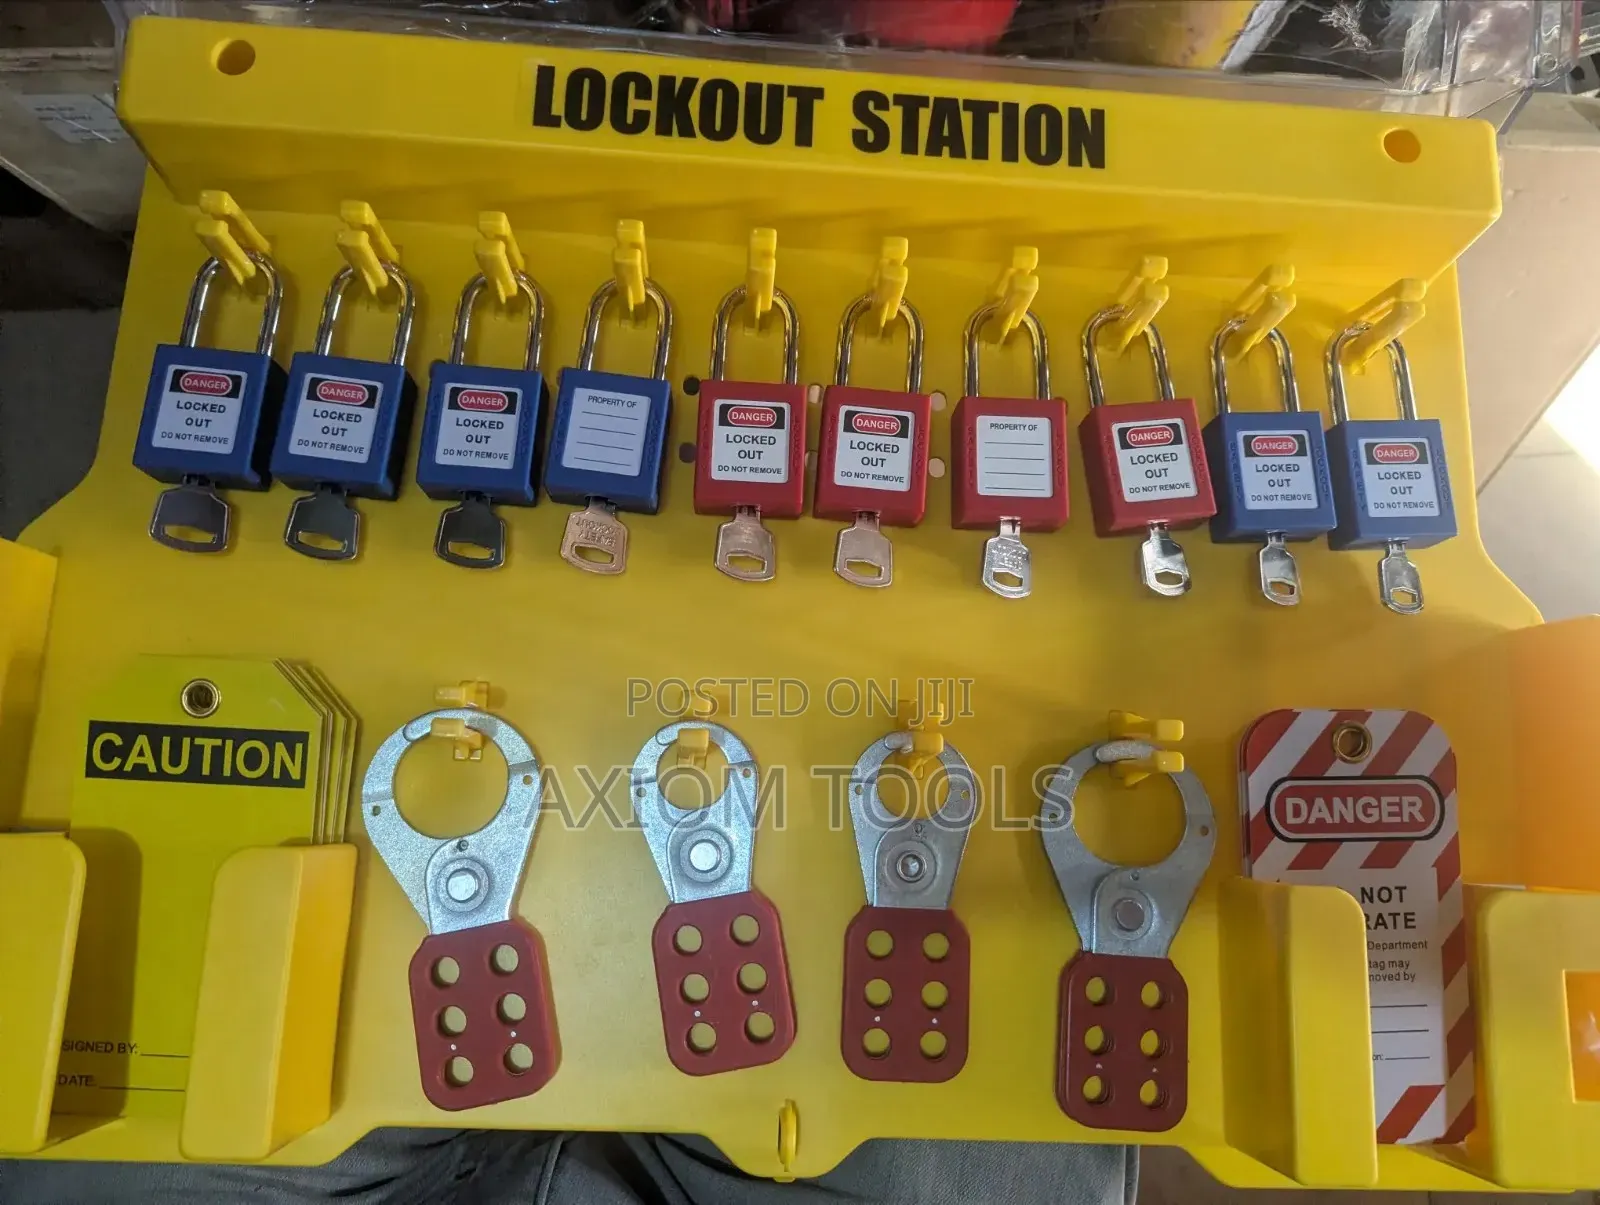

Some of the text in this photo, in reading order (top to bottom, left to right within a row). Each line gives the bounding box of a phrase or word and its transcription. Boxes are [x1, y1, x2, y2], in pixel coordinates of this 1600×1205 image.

[532, 64, 1105, 169] LOCKOUT STATION
[184, 378, 228, 390] DANGER
[320, 386, 364, 400] DANGER
[462, 395, 504, 407] DANGER
[587, 396, 638, 408] PROPERTY OF
[176, 400, 226, 414] LOCKED
[313, 409, 362, 423] LOCKED
[732, 412, 774, 422] DANGER
[185, 417, 212, 428] OUT
[456, 417, 504, 430] LOCKED
[856, 418, 898, 430] DANGER
[990, 422, 1038, 432] PROPERTY OF
[321, 426, 348, 436] OUT
[1130, 431, 1170, 442] DANGER
[194, 434, 229, 445] REMOVE
[465, 434, 491, 444] OUT
[726, 433, 777, 445] LOCKED
[311, 440, 329, 448] NOT
[330, 443, 364, 454] REMOVE
[850, 440, 900, 454] LOCKED
[1255, 442, 1294, 450] DANGER
[456, 449, 473, 457] NOT
[475, 452, 509, 460] REMOVE
[738, 450, 763, 460] OUT
[1130, 452, 1178, 465] LOCKED
[1376, 449, 1415, 458] DANGER
[861, 456, 887, 468] OUT
[1145, 468, 1169, 479] OUT
[1255, 464, 1300, 473] LOCKED
[872, 474, 904, 483] REMOVE
[1377, 471, 1422, 480] LOCKED
[1142, 485, 1157, 493] NOT
[1159, 482, 1191, 492] REMOVE
[1268, 479, 1291, 488] OUT
[1390, 486, 1414, 495] OUT
[1251, 493, 1312, 502] DO NOT REMOVE
[1403, 501, 1435, 509] REMOVE
[92, 732, 303, 780] CAUTION
[1285, 796, 1425, 824] DANGER
[1360, 886, 1407, 904] NOT
[1367, 938, 1428, 951] Department
[1369, 960, 1410, 970] tag may
[1403, 971, 1416, 982] by
